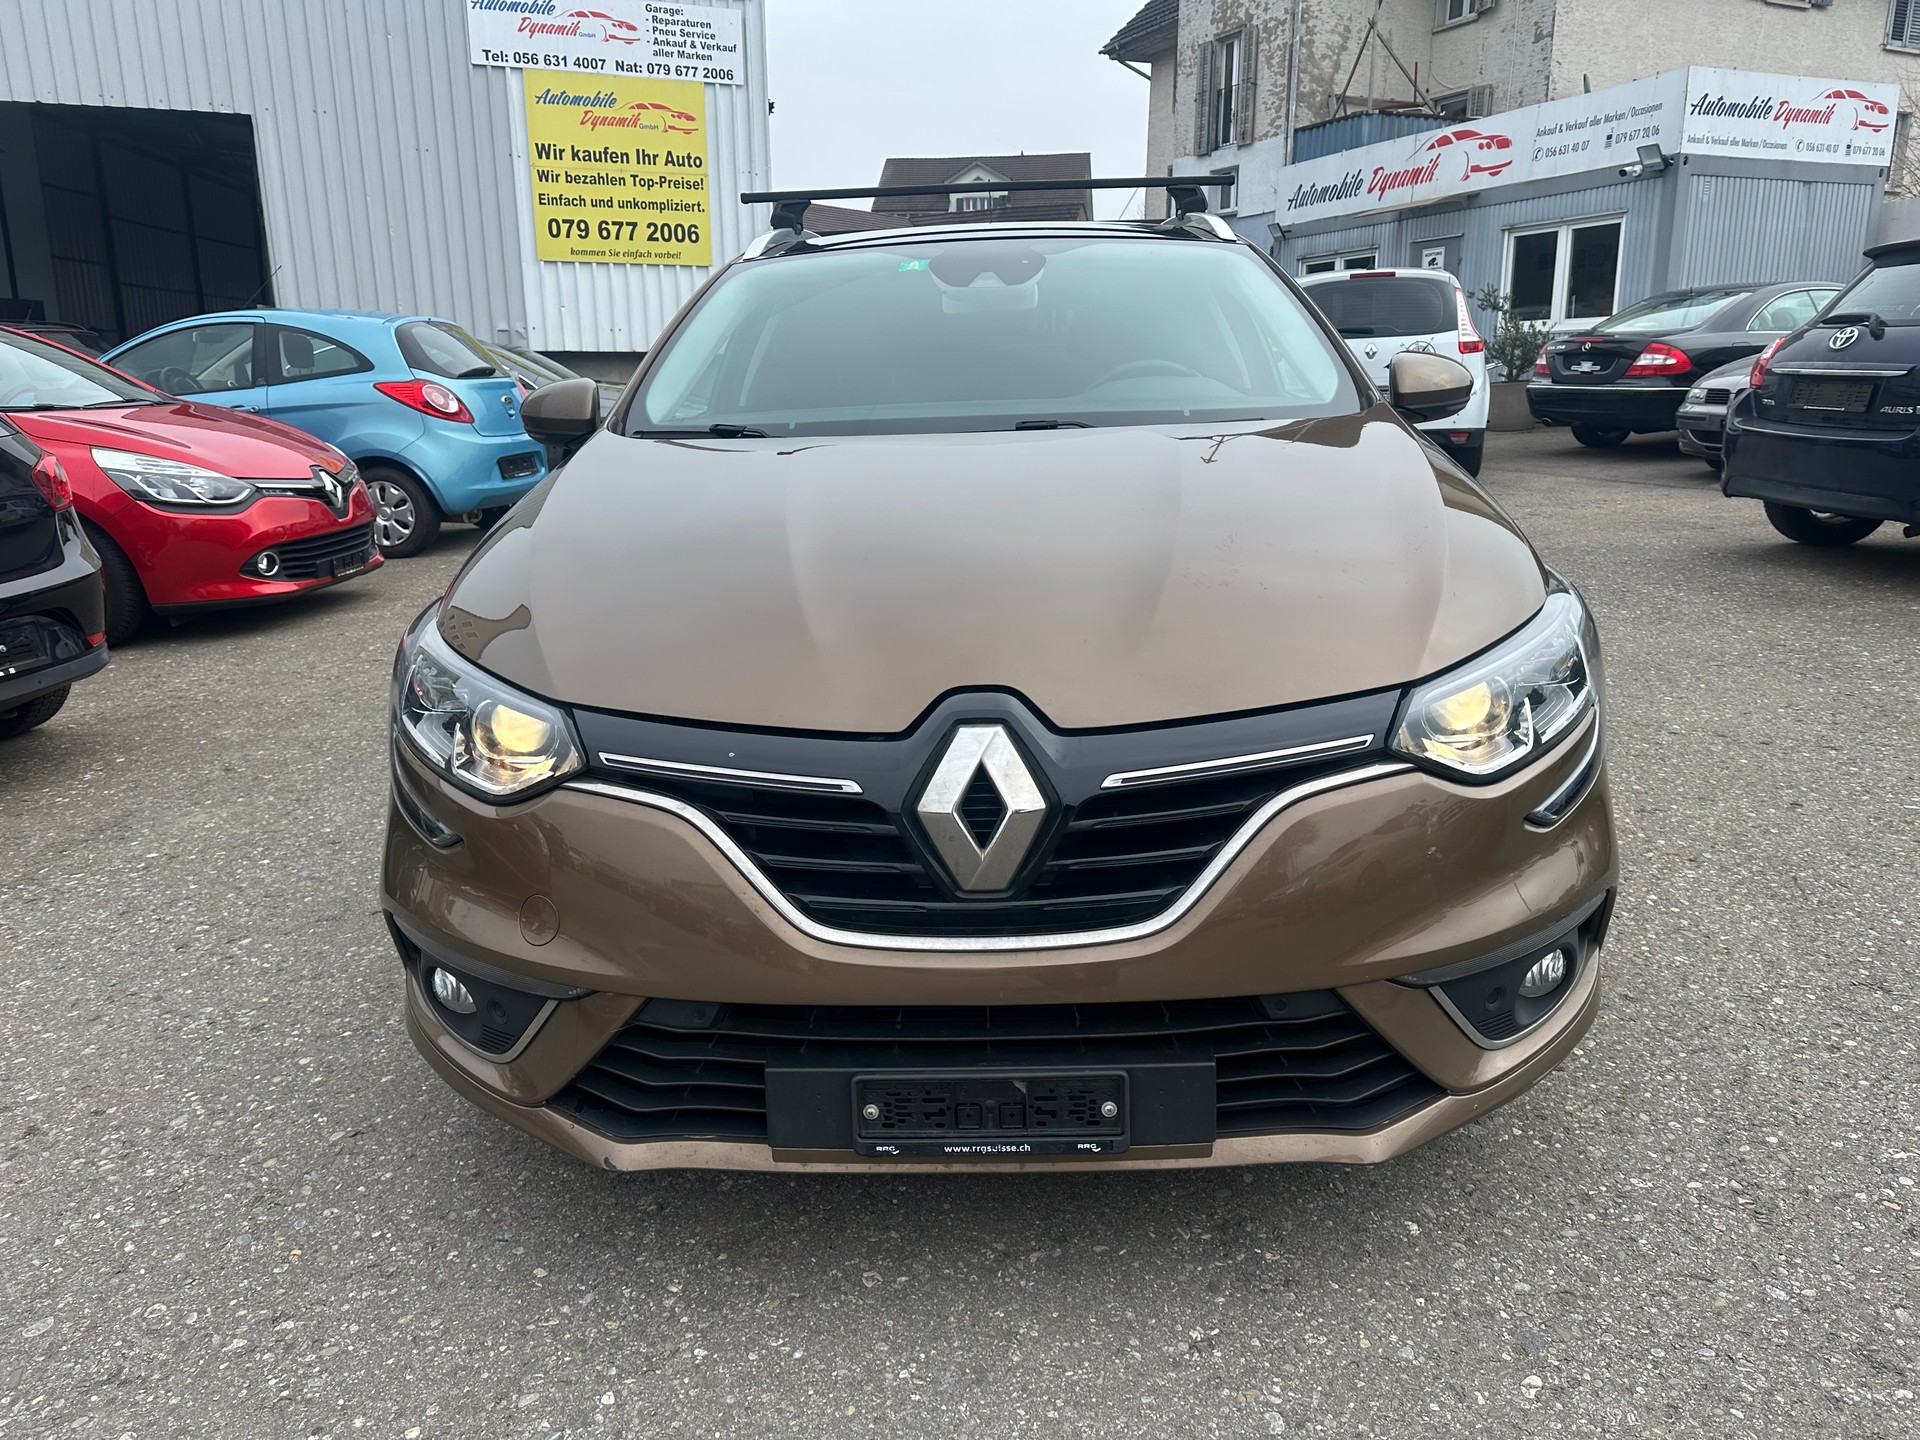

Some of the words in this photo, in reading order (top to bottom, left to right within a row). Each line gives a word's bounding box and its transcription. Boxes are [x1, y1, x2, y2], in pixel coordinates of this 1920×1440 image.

[471, 0, 556, 16] Automobile
[645, 3, 684, 17] Garage:
[517, 17, 581, 39] Dynamik
[579, 31, 596, 39] GmbH
[652, 15, 712, 29] Reparaturen
[652, 26, 677, 37] Pneu
[679, 29, 716, 40] Service
[652, 48, 675, 58] aller
[677, 50, 713, 61] Marken
[653, 37, 687, 49] Ankauf
[689, 41, 697, 50] &
[700, 41, 737, 53] Verkauf
[482, 49, 509, 63] Tel:
[513, 52, 539, 65] 056
[543, 54, 568, 67] 631
[573, 57, 606, 70] 4007
[615, 60, 643, 73] Nat:
[647, 62, 671, 76] 079
[675, 65, 698, 78] 677
[703, 67, 734, 81] 2006
[535, 88, 618, 109] Automobile
[1690, 92, 1773, 120] Automobile
[1773, 100, 1837, 130] Dynamik
[580, 110, 641, 132] Dynamik
[639, 123, 659, 131] GmbH
[1536, 123, 1559, 138] Ankauf
[1558, 125, 1564, 134] &
[1565, 117, 1588, 132] Verkauf
[1589, 115, 1603, 128] aller
[1615, 132, 1628, 145] 079
[1628, 129, 1641, 141] 677
[1641, 127, 1651, 138] 20
[1651, 124, 1660, 136] 06
[1687, 134, 1705, 144] Ankauf
[1711, 136, 1730, 146] Verkauf
[1730, 136, 1740, 147] aller
[535, 142, 565, 161] Wir
[571, 145, 630, 165] kaufen
[636, 148, 659, 166] Ihr
[664, 150, 703, 168] Auto
[1545, 147, 1557, 158] 056
[1558, 144, 1569, 156] 631
[1571, 142, 1580, 153] 40
[1581, 140, 1590, 151] 07
[1852, 145, 1862, 154] 079
[1862, 146, 1872, 155] 677
[537, 169, 560, 183] Wir
[565, 170, 626, 187] bezahlen
[630, 174, 704, 191] Top-Preise!
[1287, 168, 1364, 212] Automobile
[1367, 153, 1441, 202] Dynamik
[538, 192, 587, 208] Einfach
[591, 196, 614, 209] und
[617, 197, 705, 214] unkompliziert.
[547, 218, 590, 239] 079
[597, 220, 639, 241] 677
[646, 222, 700, 244] 2006
[570, 247, 606, 258] kommen
[608, 249, 620, 258] Sie
[622, 249, 652, 259] einfach
[654, 250, 682, 260] vorbei!
[1880, 405, 1914, 414] AURIS
[944, 1144, 1031, 1154] www.rrgsuisse.ch
